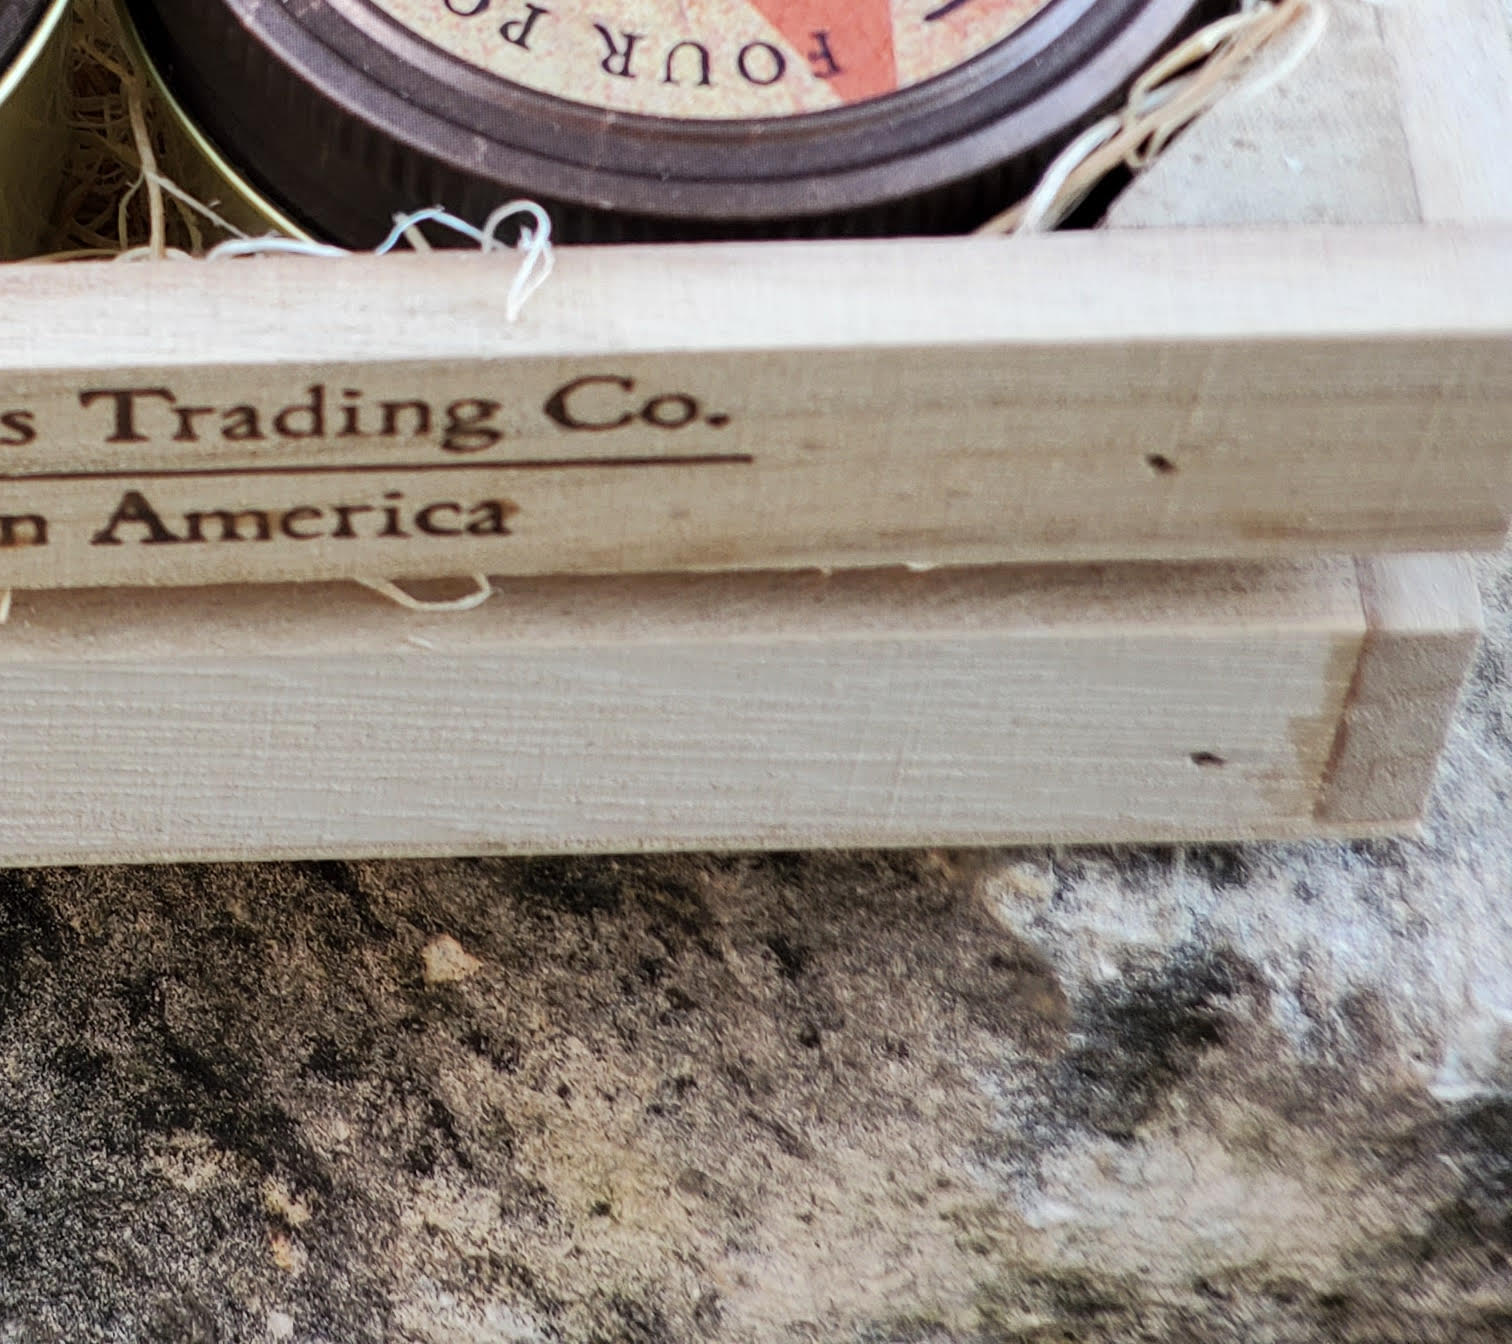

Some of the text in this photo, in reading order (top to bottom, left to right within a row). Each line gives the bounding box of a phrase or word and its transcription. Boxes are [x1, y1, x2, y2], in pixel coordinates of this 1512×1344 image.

[593, 21, 843, 88] FOUR
[80, 386, 506, 452] Trading
[543, 375, 733, 433] Co.
[91, 489, 518, 545] America
